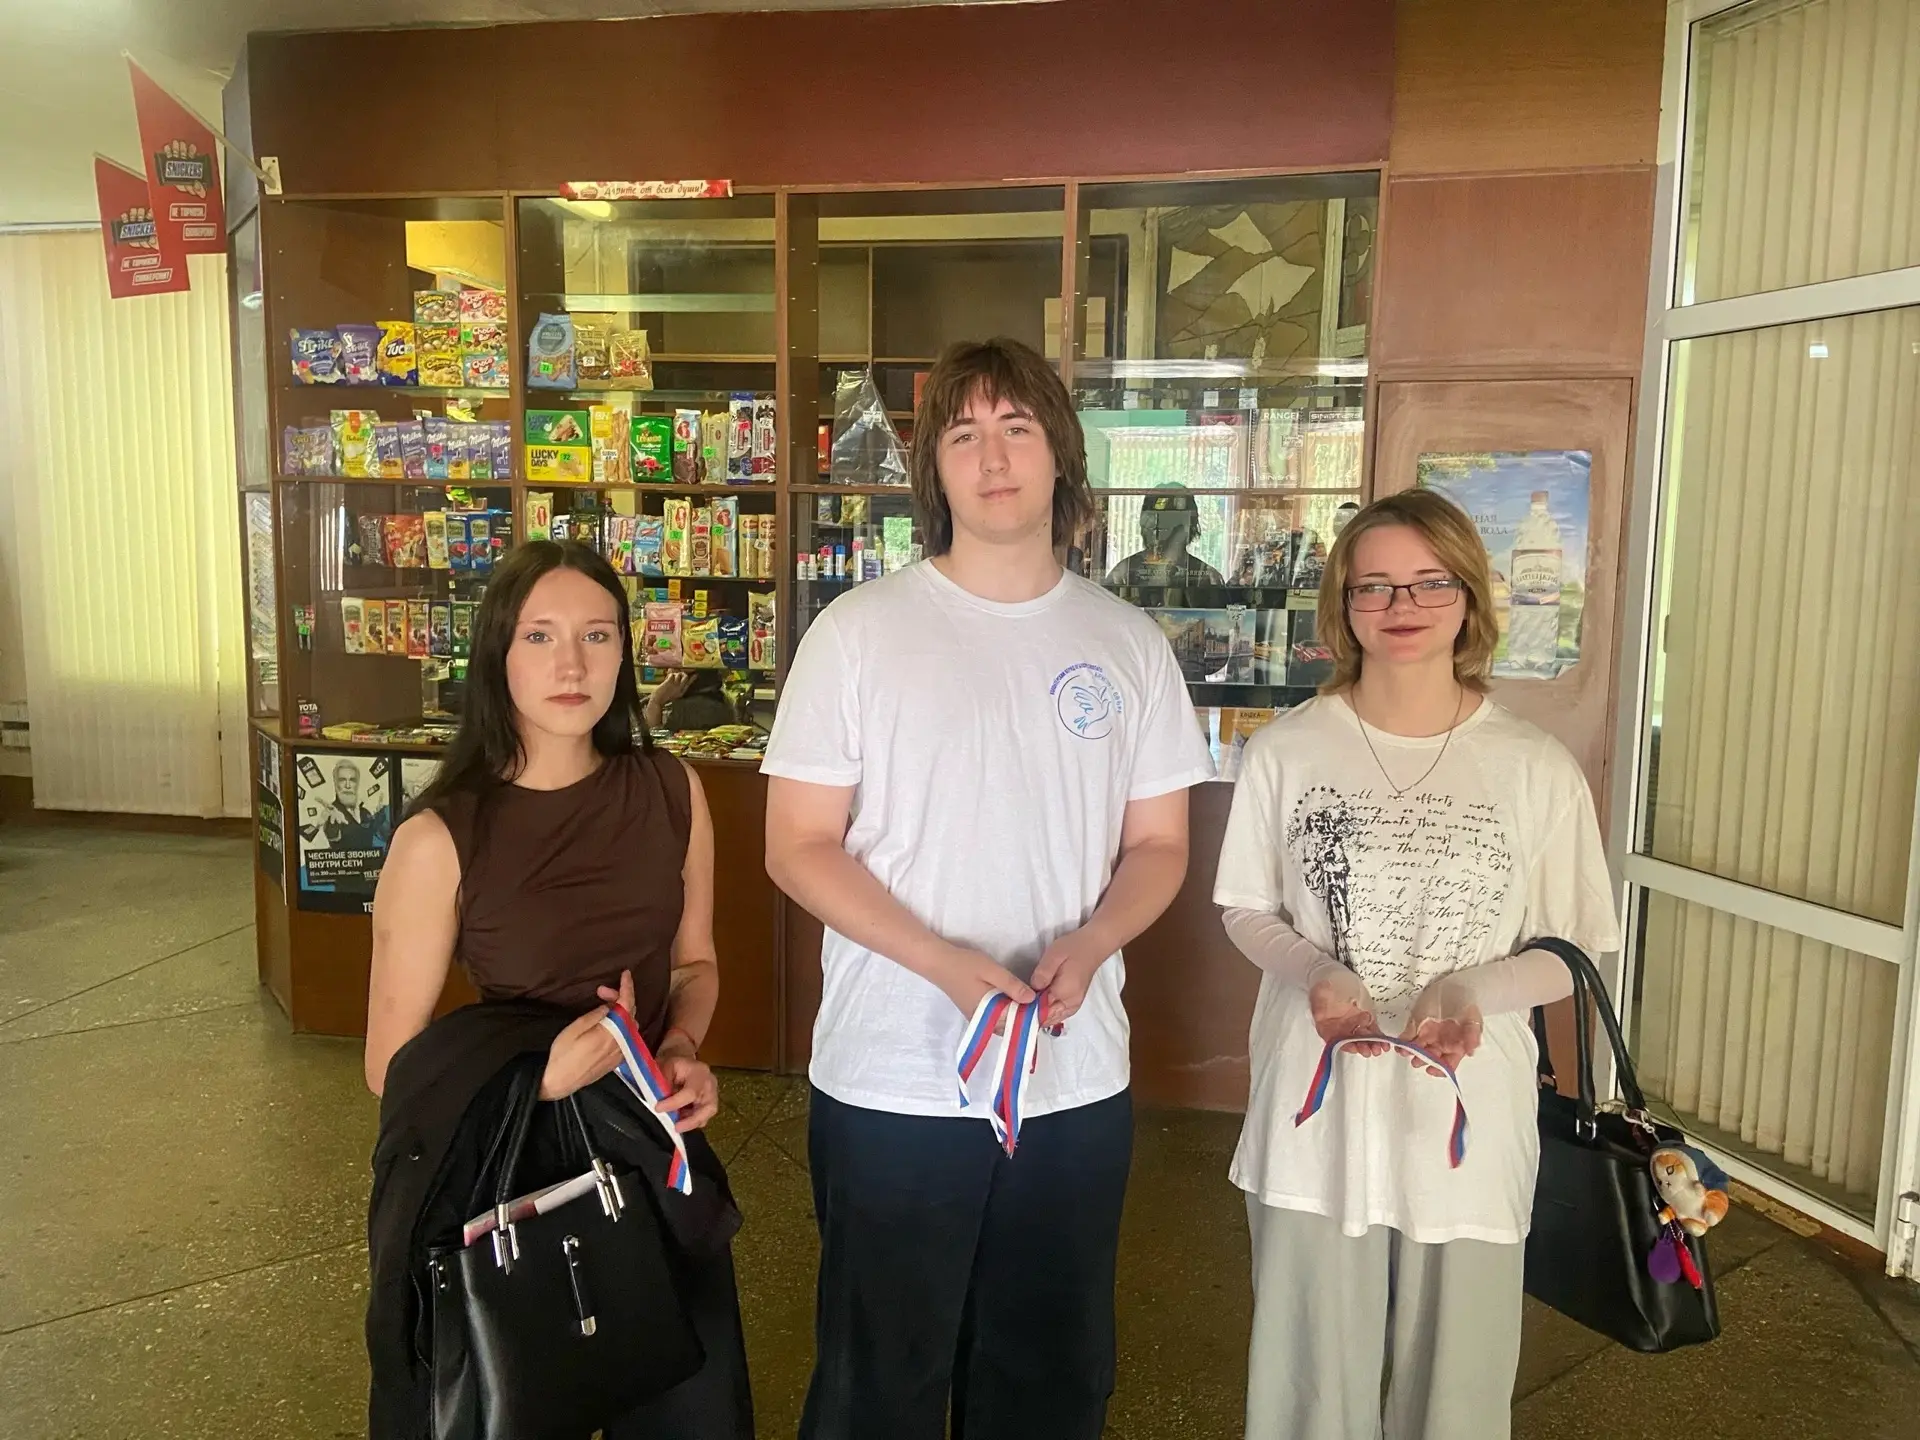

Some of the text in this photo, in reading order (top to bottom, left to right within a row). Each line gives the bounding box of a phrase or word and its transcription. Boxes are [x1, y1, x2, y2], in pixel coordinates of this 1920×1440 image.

[166, 161, 204, 178] SNICKERS
[377, 434, 399, 447] Milka
[401, 431, 422, 444] Milka
[426, 432, 447, 444] Milka
[468, 433, 491, 445] Milka
[490, 436, 511, 448] Milka
[447, 440, 468, 450] Milka
[531, 449, 559, 459] LUCKY
[531, 459, 549, 467] DAYS
[1480, 526, 1508, 535] ВОДА
[299, 703, 318, 712] YOTA
[307, 849, 380, 860] ЧЕСТНЫЕ ЗВОНКИ
[309, 859, 363, 869] ВНУТРИ СЕТИ
